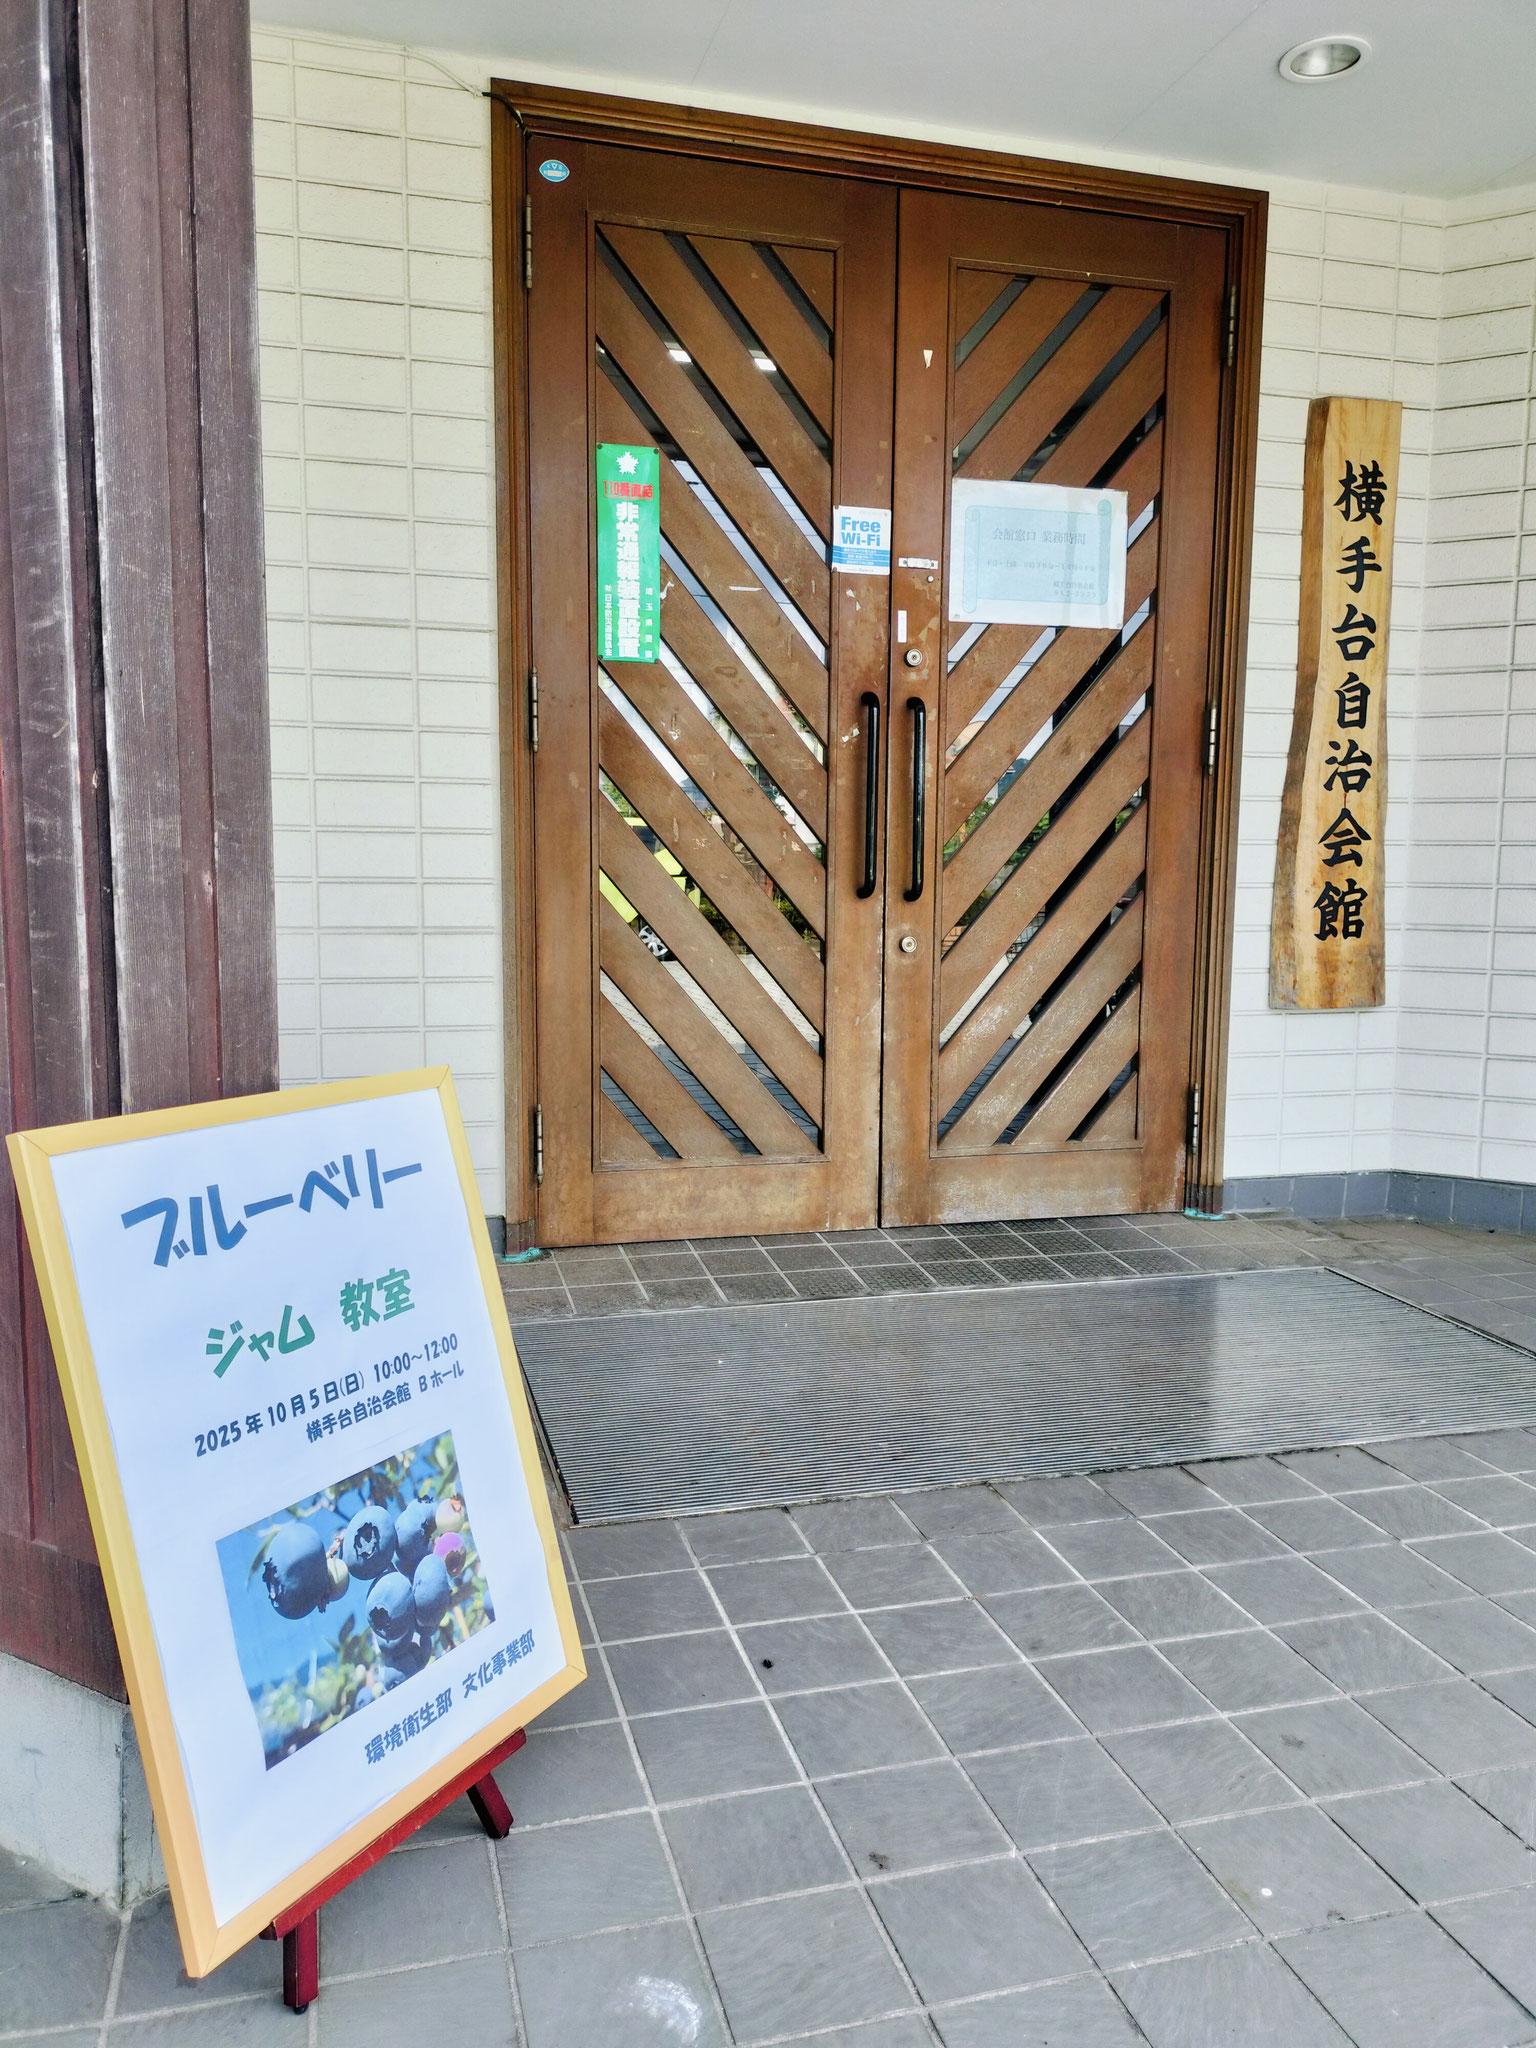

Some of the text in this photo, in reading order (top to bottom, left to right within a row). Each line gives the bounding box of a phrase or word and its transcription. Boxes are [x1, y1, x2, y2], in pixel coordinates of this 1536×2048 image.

[603, 480, 654, 498] 110番直結
[841, 516, 881, 533] Free
[616, 502, 640, 657] 非常通報装置設置
[840, 532, 881, 547] Wi-Fi
[992, 527, 1087, 545] 会館窓口 業務時間
[1312, 459, 1389, 941] 横手台自治会館
[120, 1148, 423, 1268] ブルーベリー
[205, 1267, 416, 1379] ジャム 教室
[305, 1381, 412, 1444] 横手台自治会館
[364, 1628, 536, 1765] 環境衛生部 文化事業部
